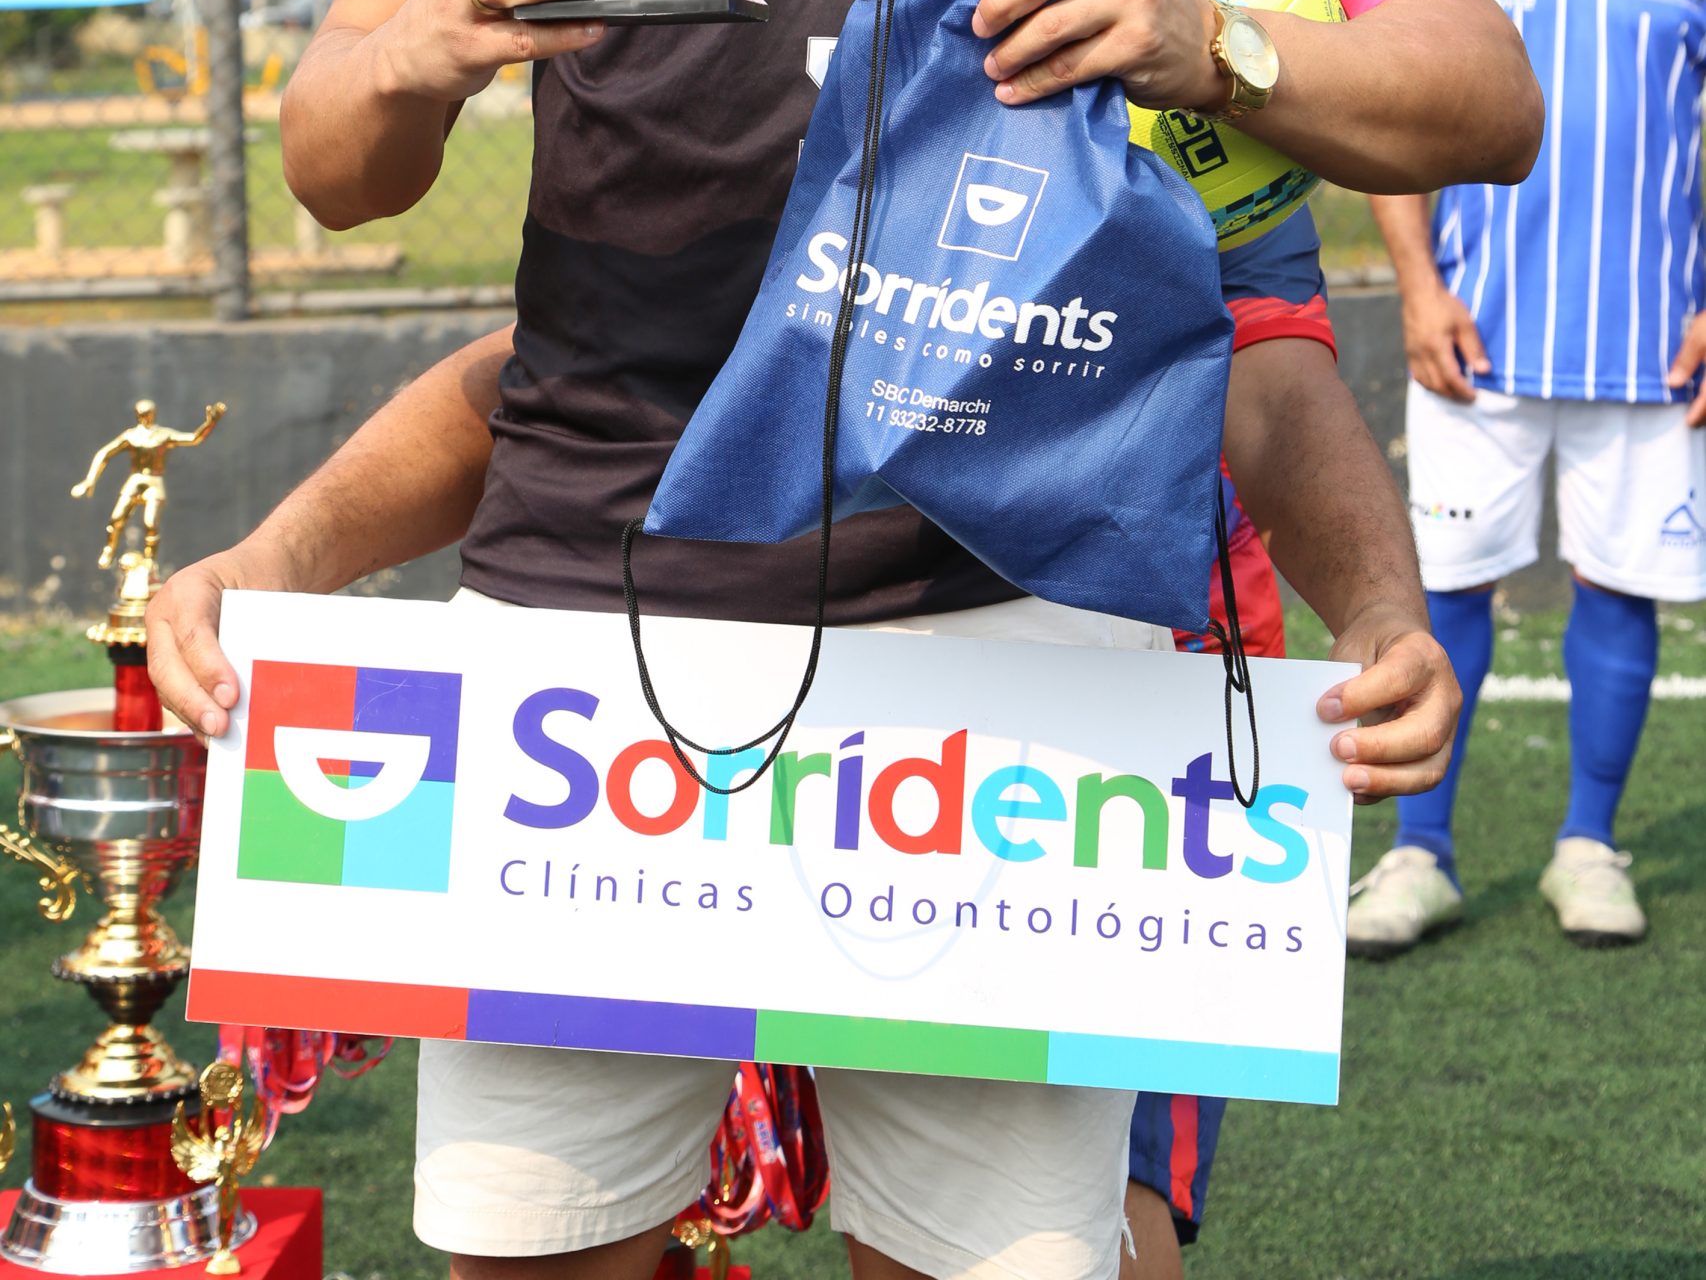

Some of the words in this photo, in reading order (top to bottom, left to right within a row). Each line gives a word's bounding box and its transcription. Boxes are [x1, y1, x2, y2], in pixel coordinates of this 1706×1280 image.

[785, 302, 907, 352] simles
[922, 340, 993, 369] como
[1013, 355, 1106, 379] sorrir
[865, 401, 885, 422] 11
[889, 407, 987, 436] 93232-8778
[871, 379, 911, 405] SBC
[910, 388, 992, 415] Demarchi
[500, 858, 753, 912] Clínicas
[820, 882, 1303, 953] Odontológicas
